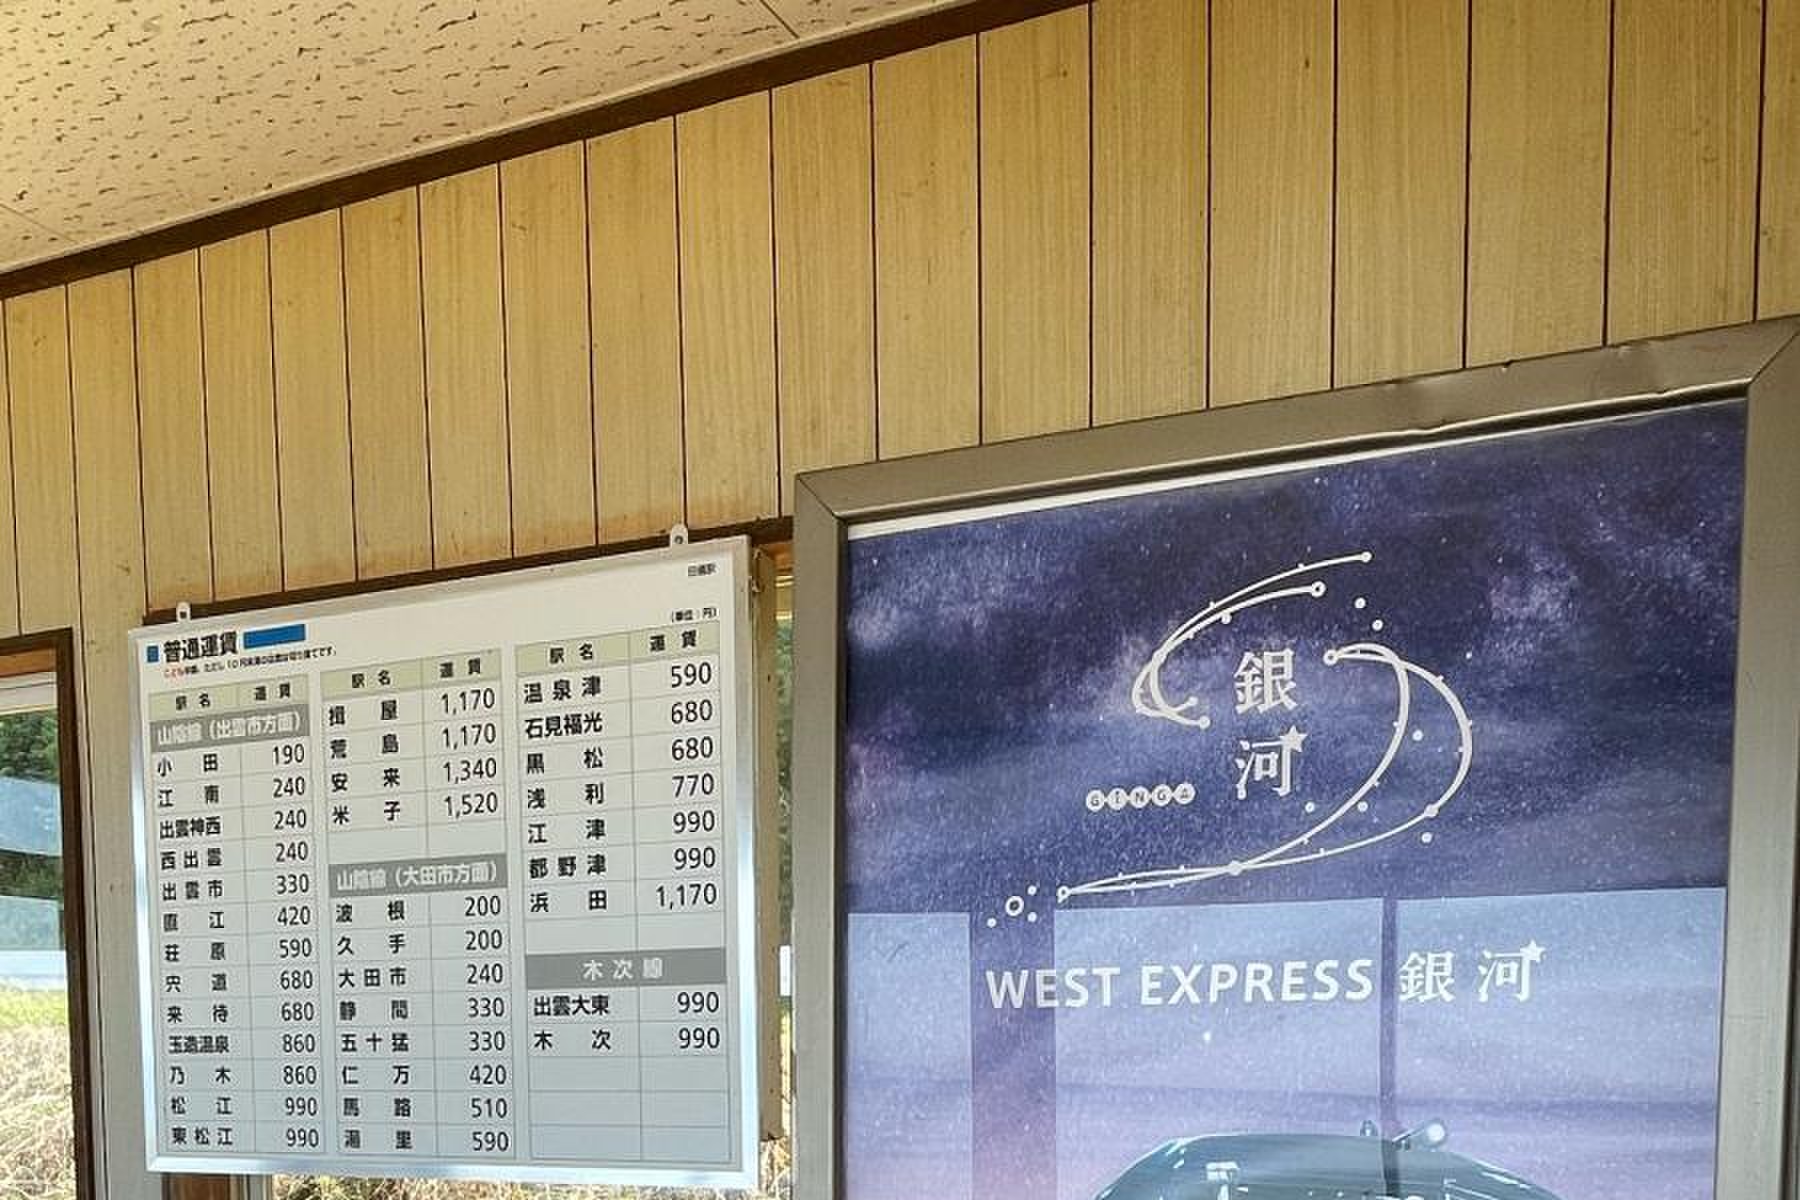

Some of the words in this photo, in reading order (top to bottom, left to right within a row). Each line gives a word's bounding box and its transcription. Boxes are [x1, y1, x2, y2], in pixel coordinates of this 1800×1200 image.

[164, 631, 238, 663] 普通運賃
[650, 629, 697, 652] 運賃
[440, 657, 481, 678] 運賃
[671, 662, 712, 688] 590
[254, 682, 291, 702] 運賃
[441, 687, 495, 715] 1,170
[671, 699, 713, 724] 680
[1234, 647, 1307, 800] 銀河
[442, 723, 496, 750] 1,170
[273, 743, 305, 765] 190
[671, 736, 714, 761] 680
[443, 757, 497, 785] 1,340
[273, 776, 305, 798] 240
[672, 773, 715, 798] 770
[444, 792, 498, 819] 1,520
[274, 809, 306, 830] 240
[673, 810, 715, 834] 990
[276, 841, 308, 862] 240
[674, 846, 716, 870] 990
[276, 874, 309, 894] 330
[465, 895, 501, 917] 200
[656, 883, 717, 910] 1,170
[277, 906, 310, 926] 420
[279, 938, 312, 958] 590
[465, 929, 502, 951] 200
[280, 970, 313, 990] 680
[467, 963, 503, 984] 240
[986, 966, 1121, 1008] WEST
[1140, 959, 1373, 1004] EXPRESS
[1399, 940, 1546, 1003] 銀河
[281, 1002, 314, 1021] 680
[468, 997, 504, 1018] 330
[677, 991, 720, 1014] 990
[282, 1033, 315, 1053] 860
[469, 1030, 505, 1051] 330
[678, 1027, 721, 1049] 990
[283, 1065, 317, 1085] 860
[469, 1064, 507, 1085] 420
[285, 1097, 318, 1116] 990
[471, 1098, 507, 1118] 510
[286, 1128, 319, 1147] 990
[472, 1131, 509, 1151] 590
